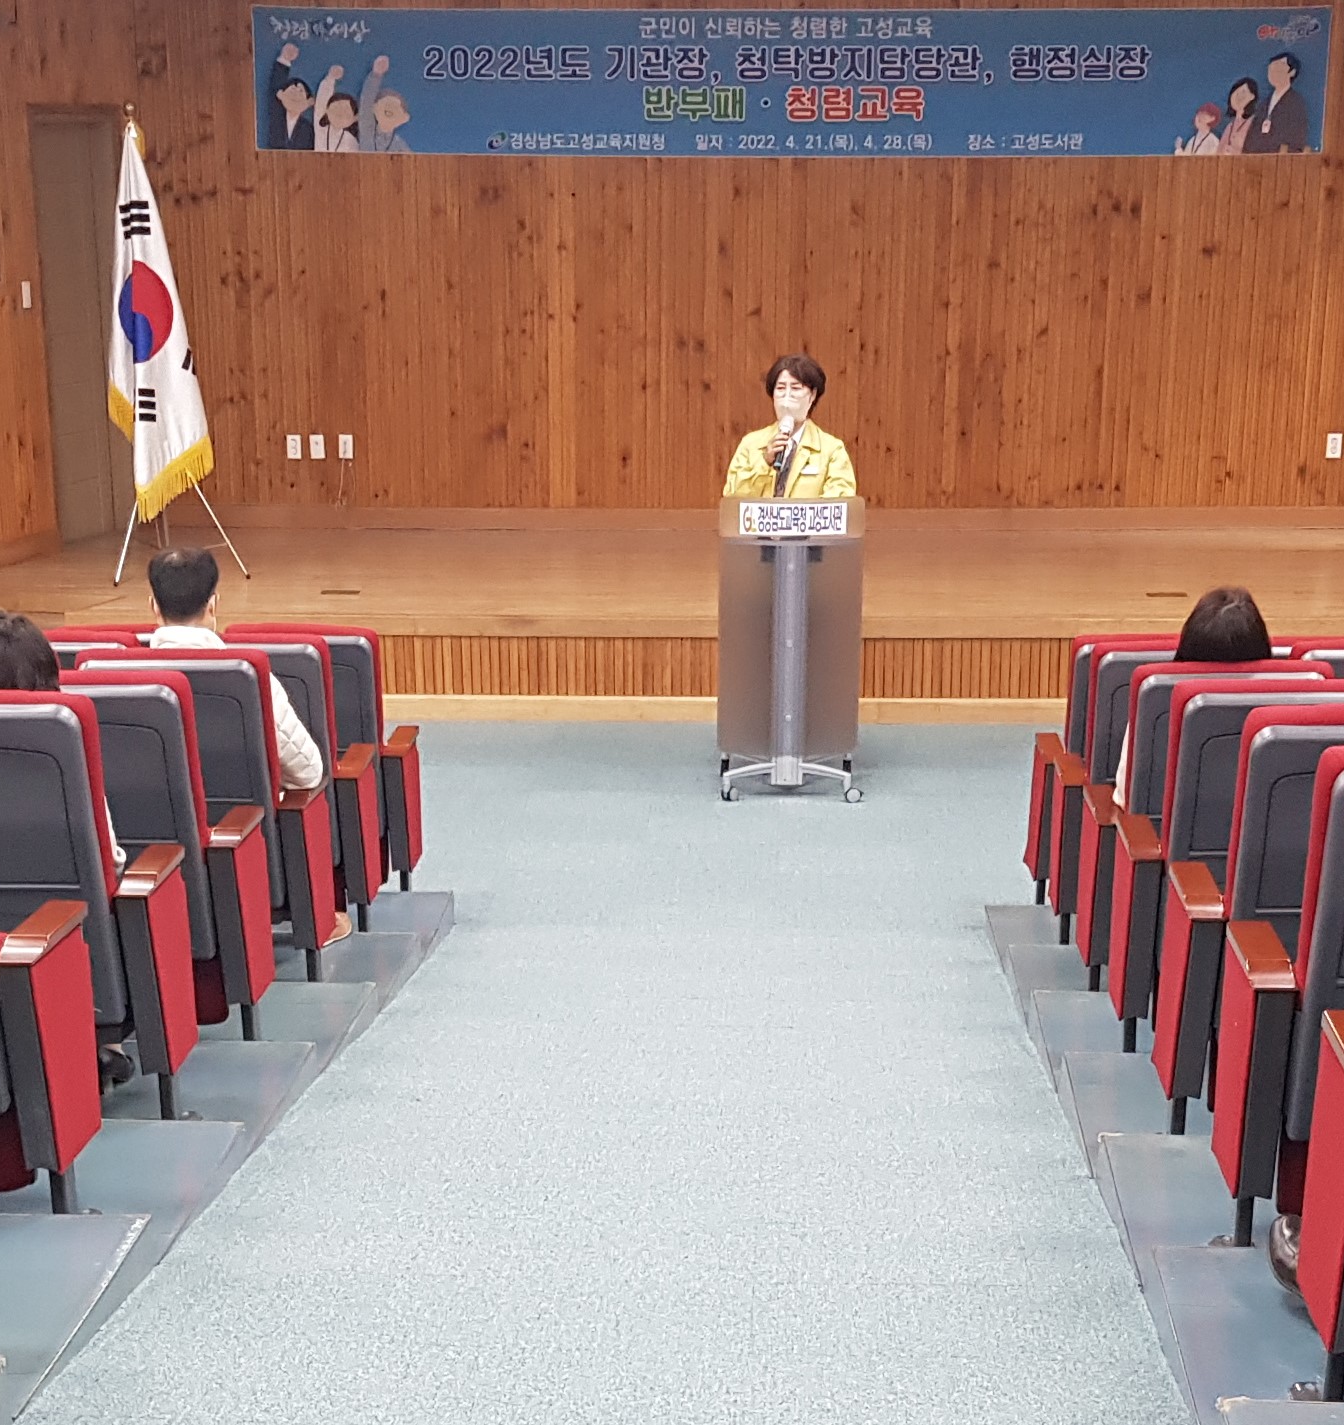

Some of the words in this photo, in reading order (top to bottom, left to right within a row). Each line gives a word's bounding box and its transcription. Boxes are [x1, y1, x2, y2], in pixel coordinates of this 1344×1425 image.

[638, 16, 696, 39] 군민이
[704, 16, 782, 39] 신뢰하는
[790, 16, 848, 39] 청렴한
[856, 17, 933, 39] 고성교육
[423, 45, 592, 80] 2022년도
[605, 45, 722, 86] 기관장,
[735, 45, 994, 86] 청탁방지담당관,
[1008, 45, 1152, 81] 행정실장
[643, 86, 747, 121] 반부패
[785, 86, 925, 121] 청렴교육
[510, 134, 665, 150] 경상남도고성교육지원청
[695, 135, 723, 150] 일자
[967, 134, 997, 150] 장소
[1010, 134, 1084, 150] 고성도서관
[757, 506, 807, 532] 경상남도교육청
[808, 505, 843, 532] 고성도서관
